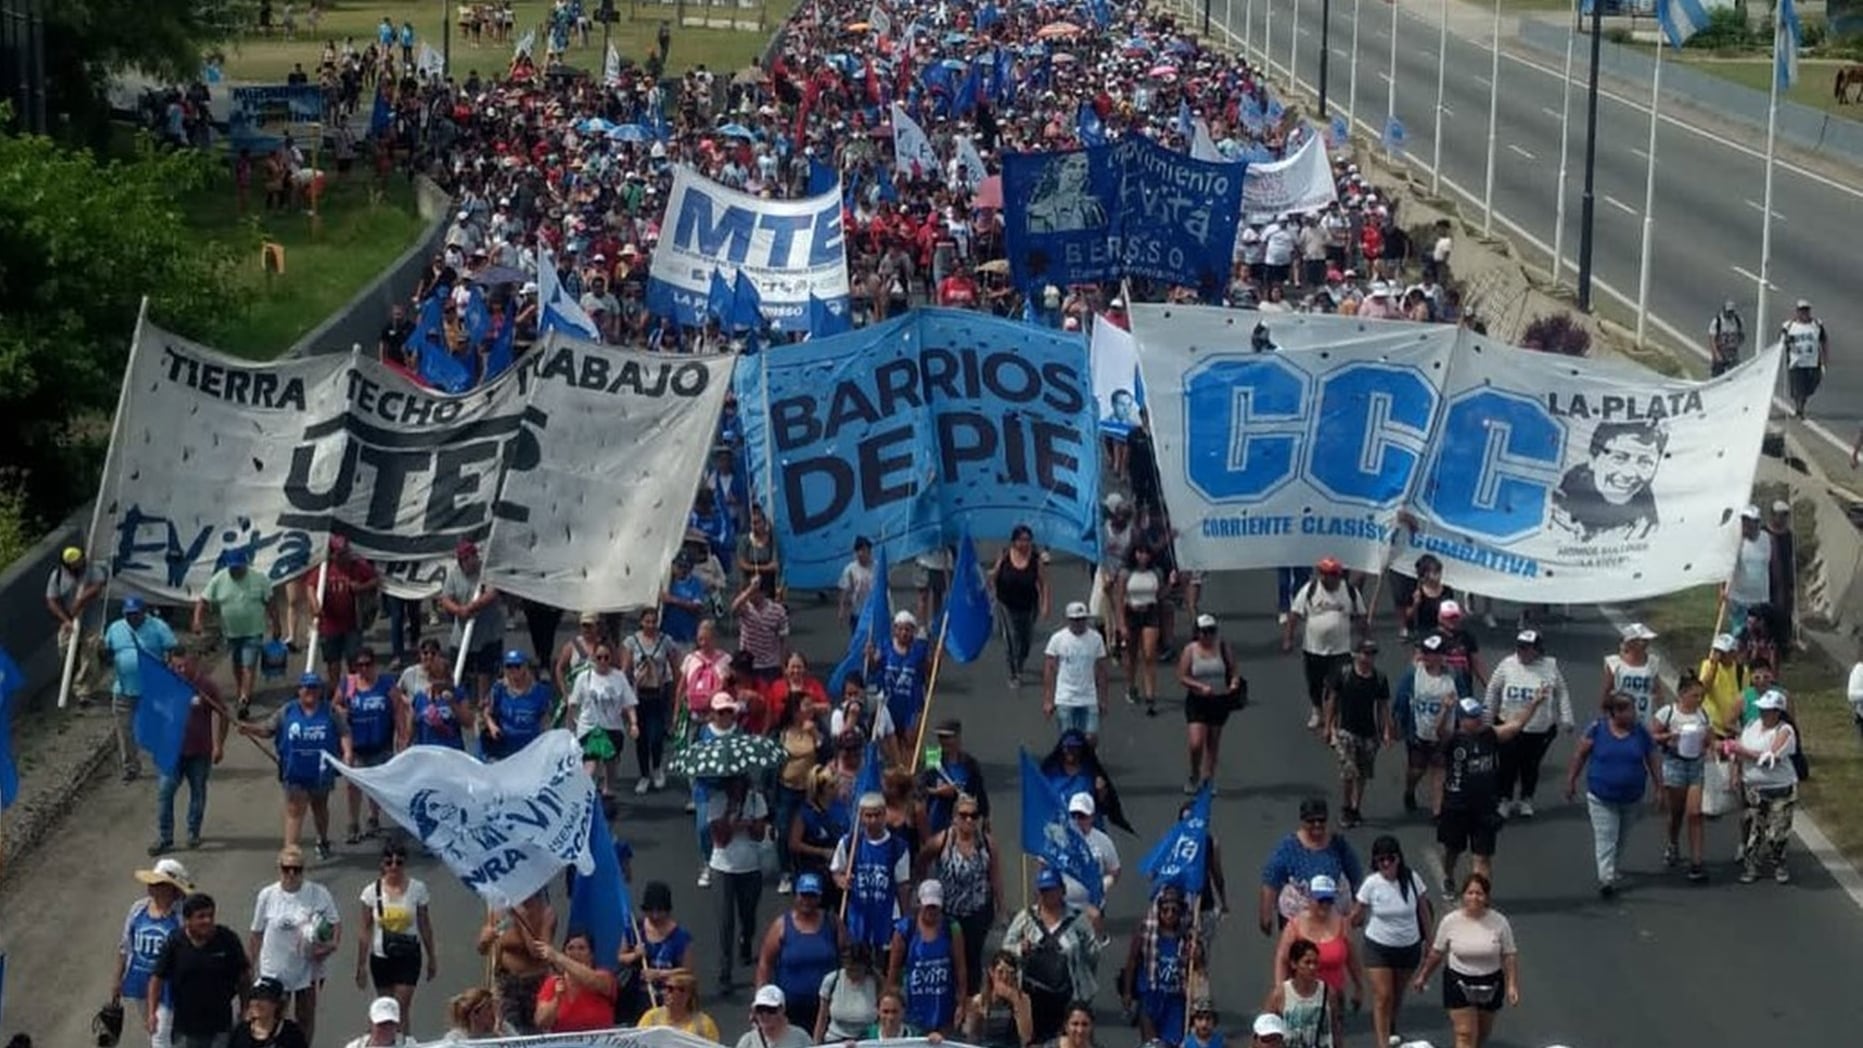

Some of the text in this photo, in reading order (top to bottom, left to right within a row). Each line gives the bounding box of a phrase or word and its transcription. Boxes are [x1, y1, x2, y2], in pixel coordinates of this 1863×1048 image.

[672, 186, 844, 268] MTE
[165, 346, 306, 412] TIERRA
[344, 368, 463, 424] TECHO
[770, 347, 1085, 453] BARRIOS
[1549, 390, 1704, 420] LA PLATA
[283, 423, 542, 531] UTEP
[782, 410, 1083, 536] DE PIE
[1182, 352, 1569, 546] CCC
[1203, 515, 1294, 538] CORRIENTE
